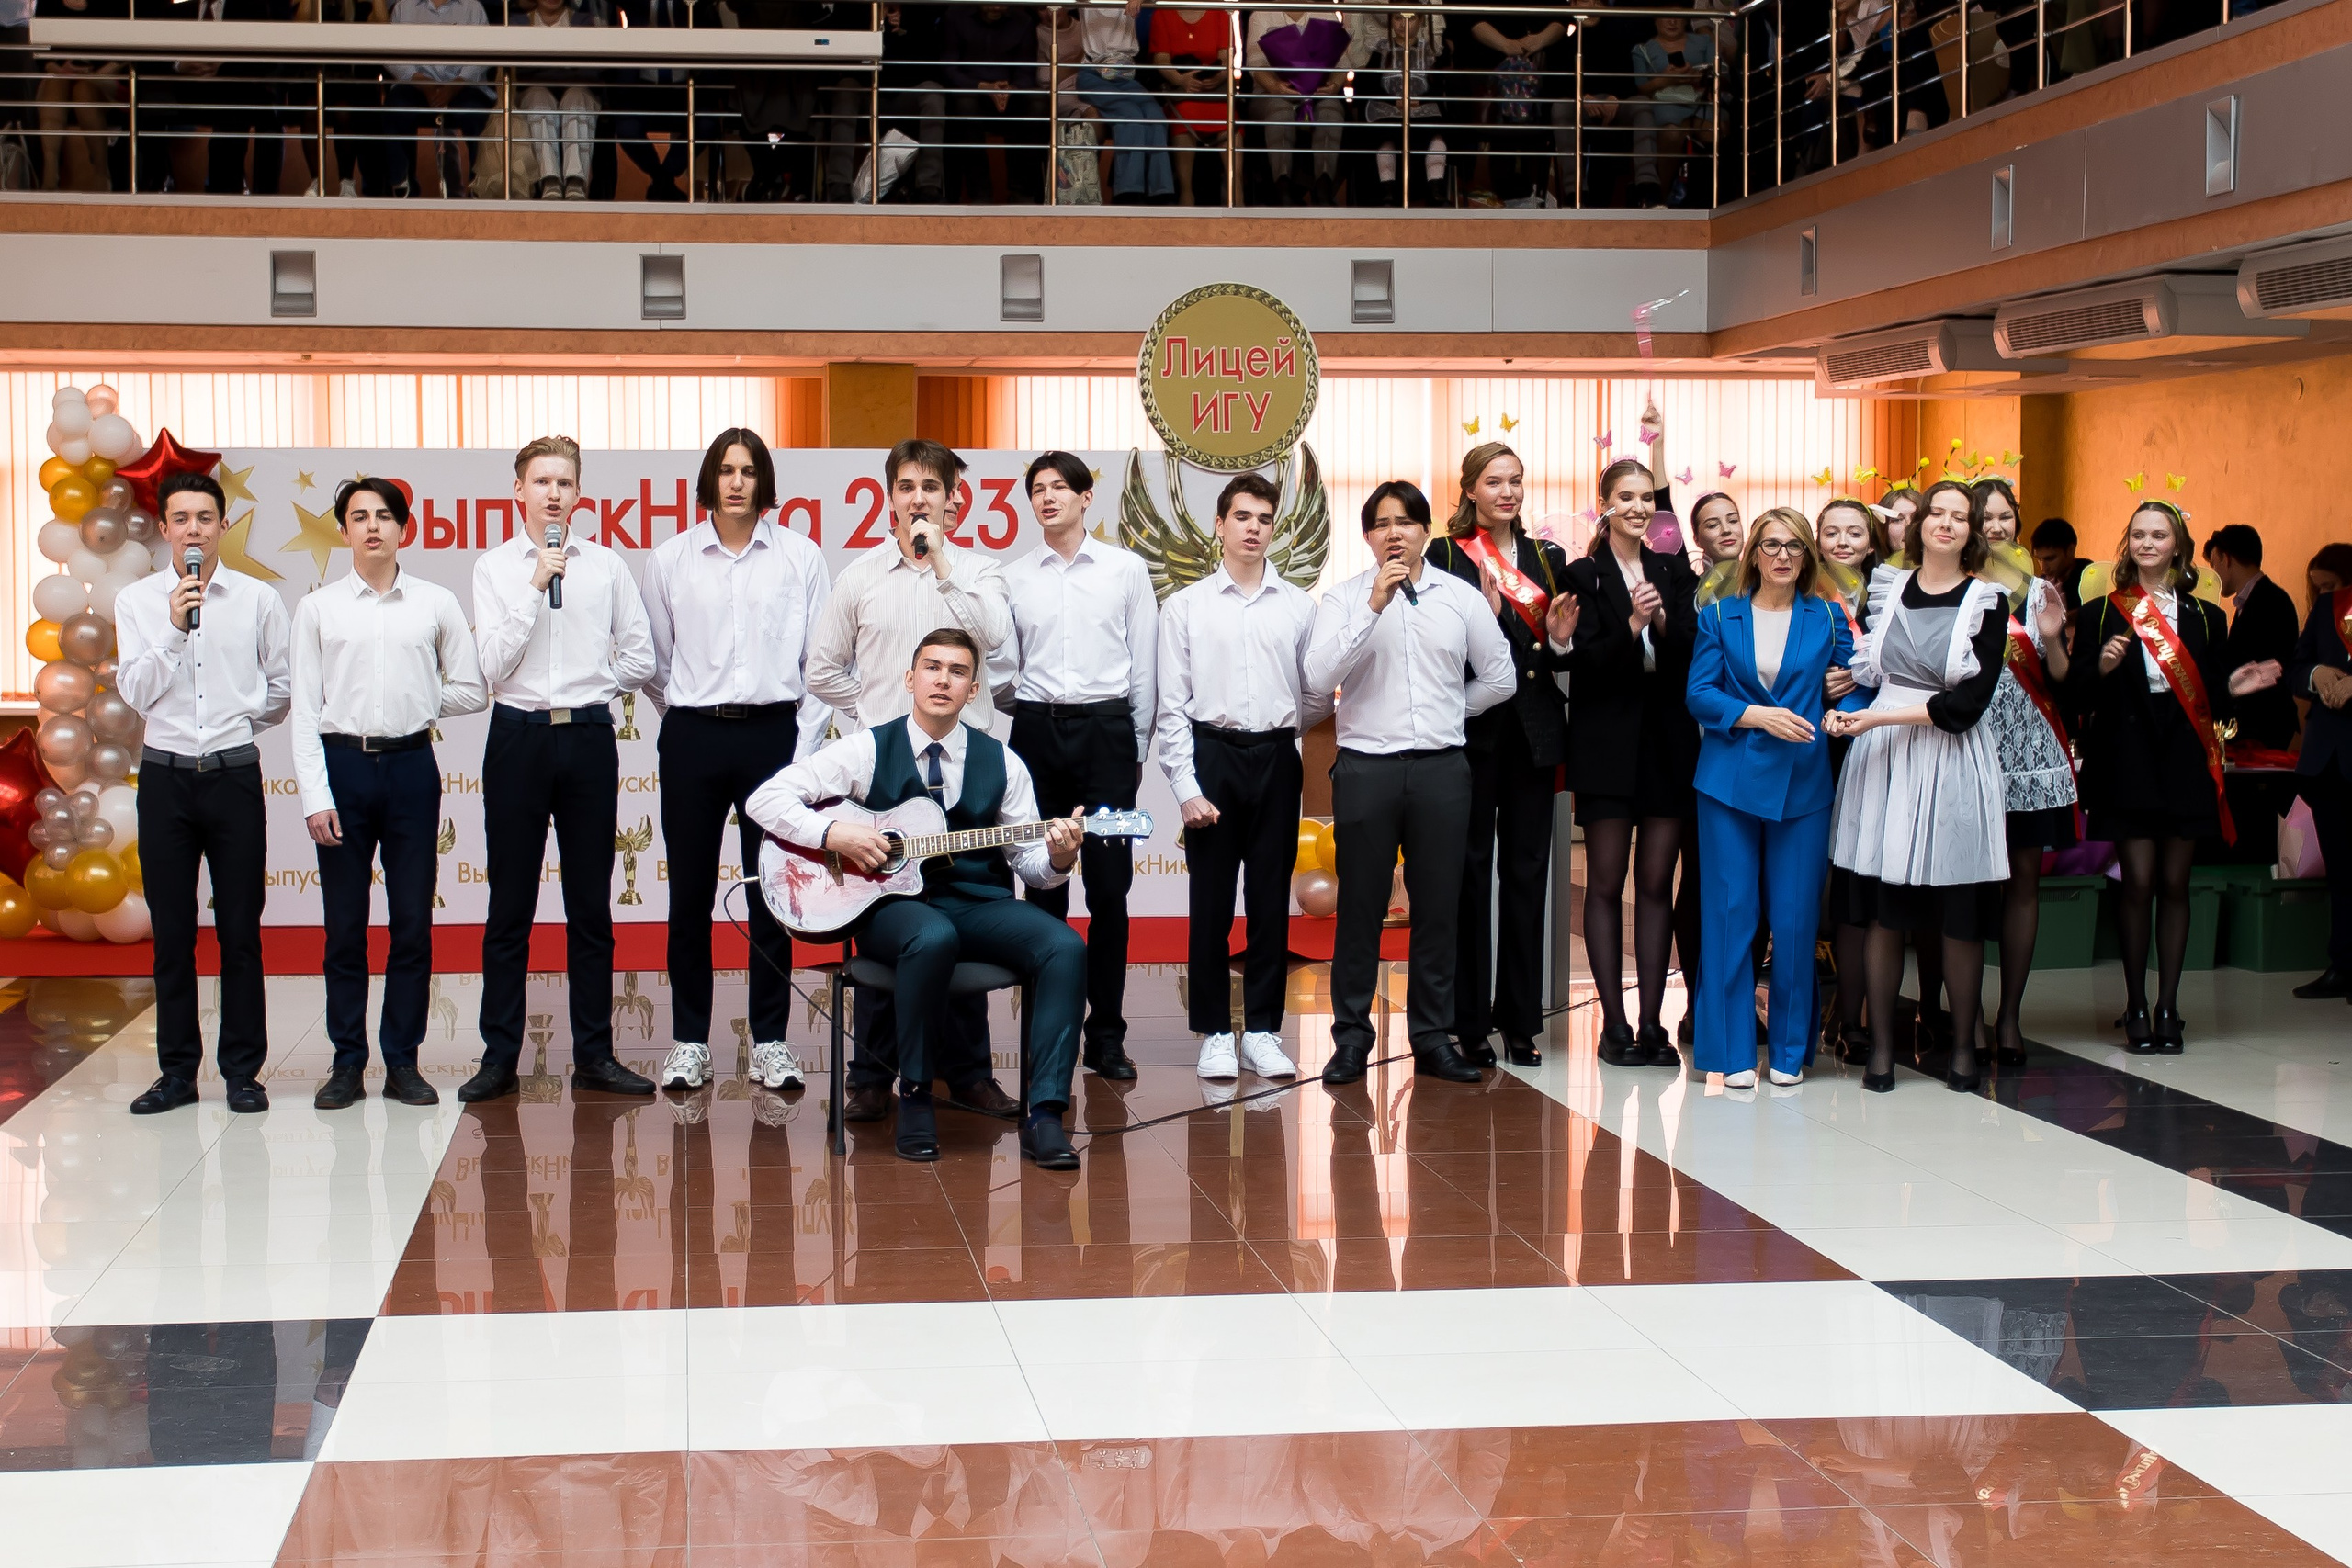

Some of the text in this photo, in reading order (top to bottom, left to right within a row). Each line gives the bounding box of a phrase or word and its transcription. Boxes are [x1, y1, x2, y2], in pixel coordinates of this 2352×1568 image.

[1161, 336, 1296, 383] Лицей
[1192, 390, 1272, 435] ИГУ
[842, 477, 1019, 550] 223
